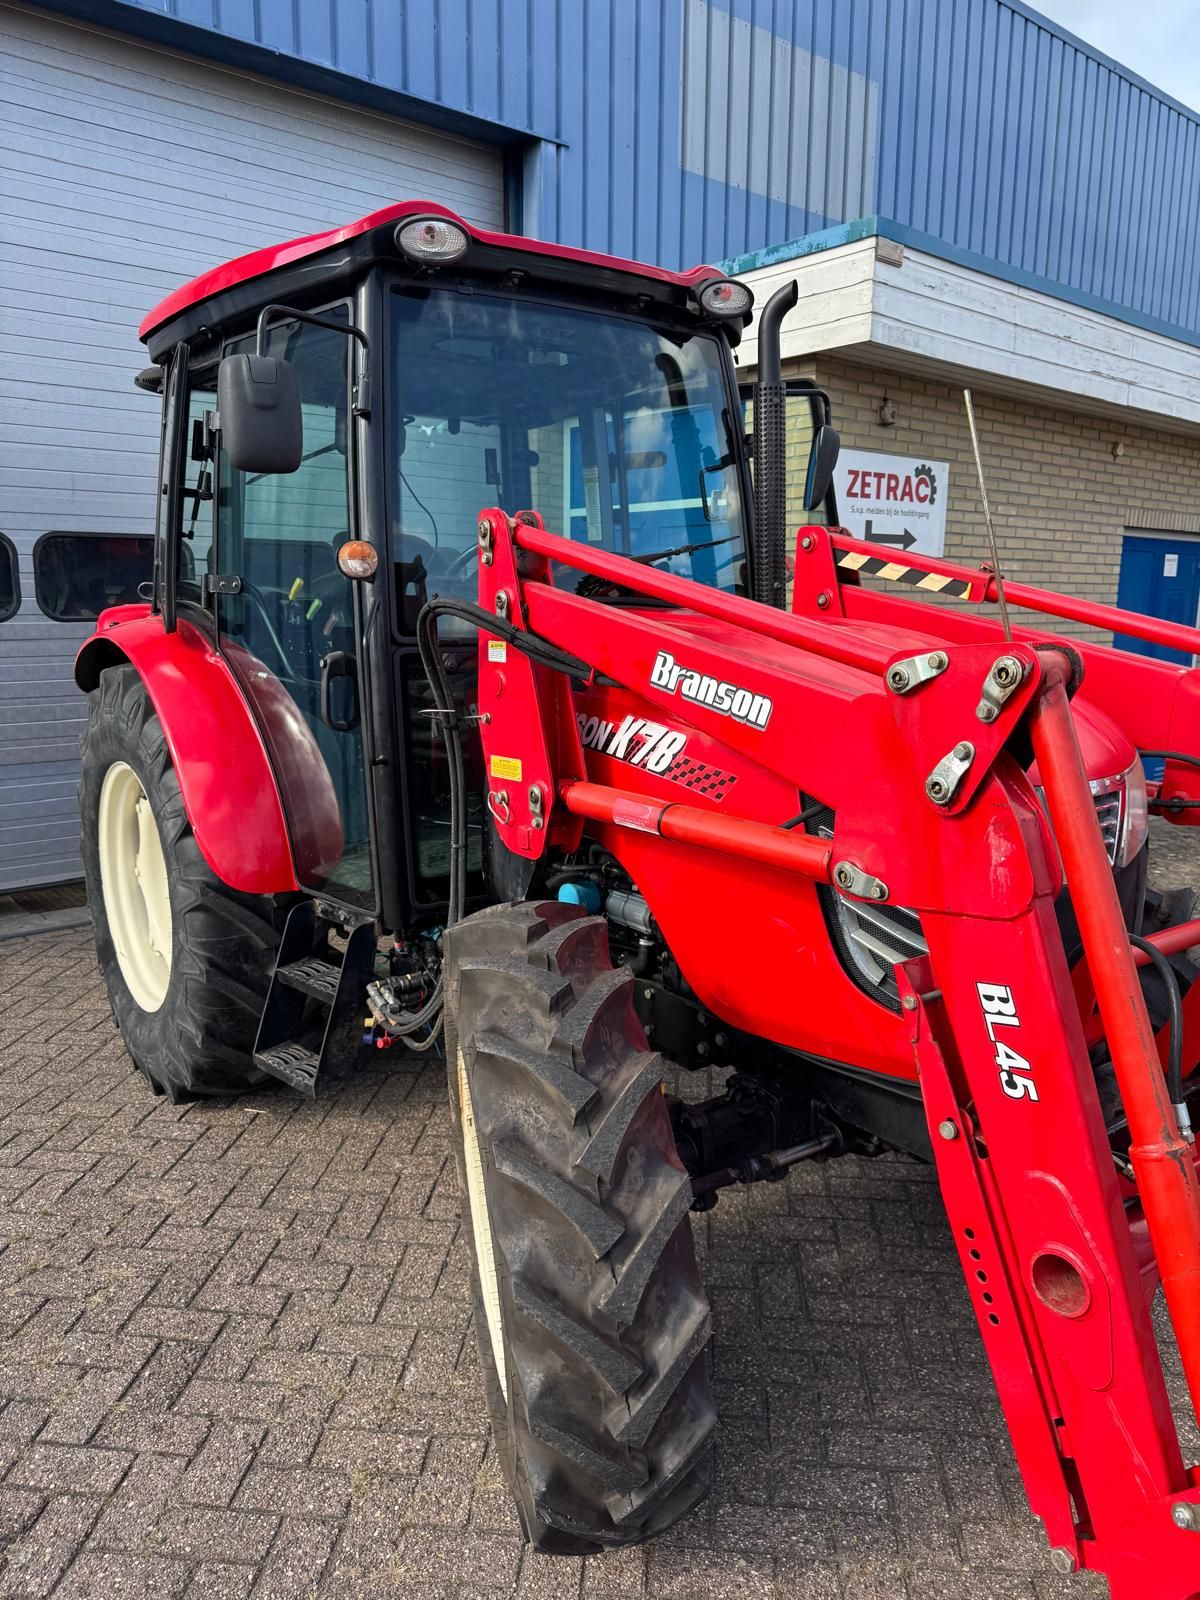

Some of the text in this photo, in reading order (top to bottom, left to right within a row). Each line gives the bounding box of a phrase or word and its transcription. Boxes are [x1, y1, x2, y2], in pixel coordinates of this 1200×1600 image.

[846, 469, 930, 504] ZETRAC
[866, 506, 886, 515] melden
[893, 508, 900, 516] de
[900, 509, 930, 520] hoofdingang
[649, 649, 773, 731] Branson
[576, 712, 687, 773] SON K78
[975, 981, 1040, 1103] BL45
